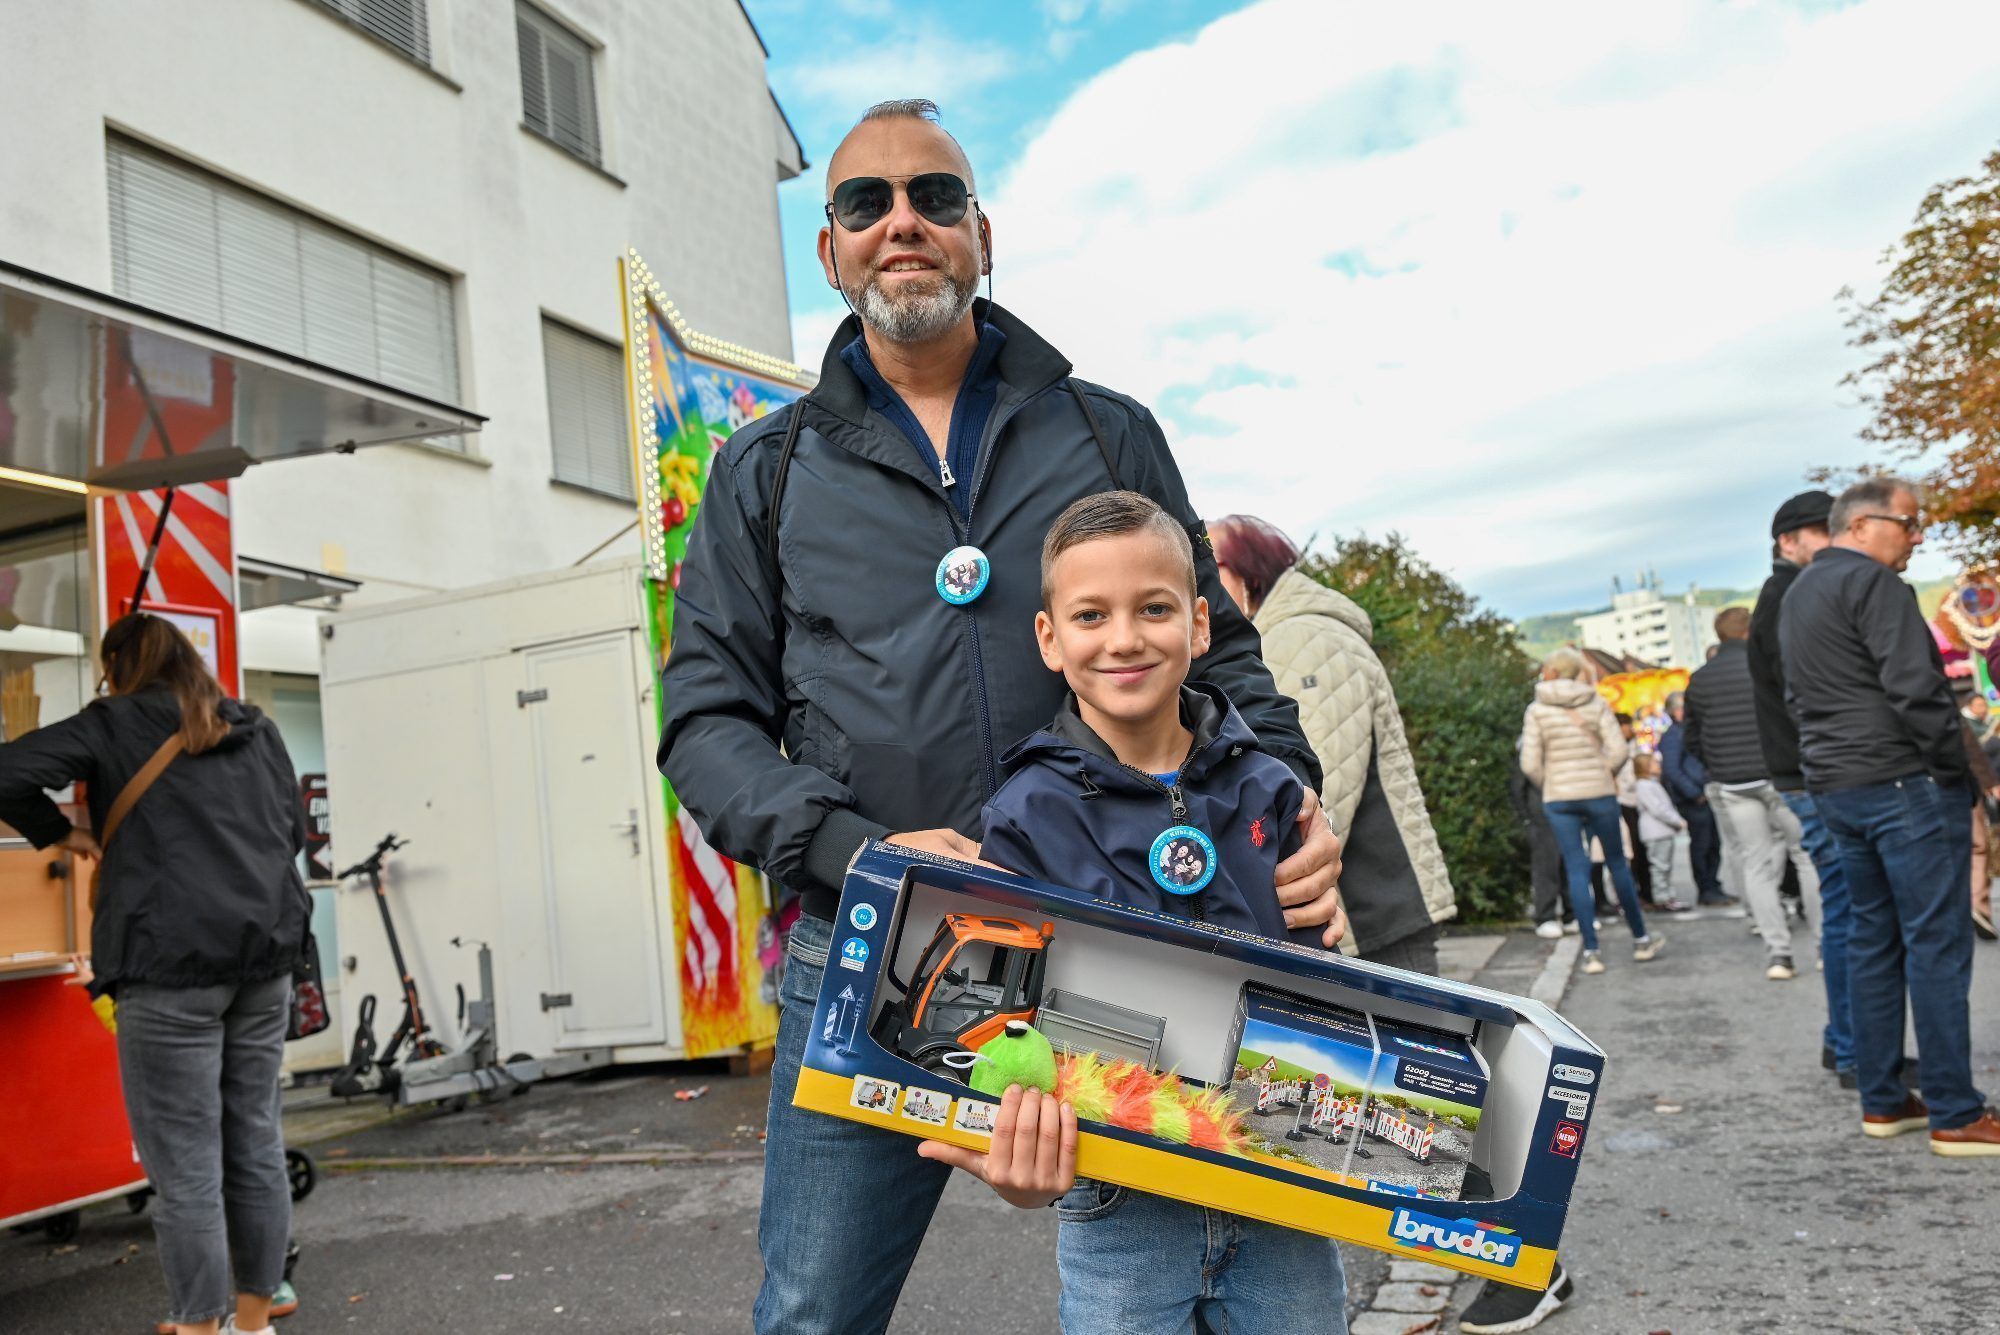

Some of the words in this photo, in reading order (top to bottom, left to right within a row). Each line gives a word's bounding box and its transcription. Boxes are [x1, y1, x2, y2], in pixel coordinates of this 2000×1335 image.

[844, 941, 867, 958] 4+
[1404, 1064, 1430, 1078] 62009
[1552, 1089, 1588, 1101] ACCESSORIES
[1558, 1132, 1575, 1143] NEW
[1393, 1209, 1514, 1263] bruder
